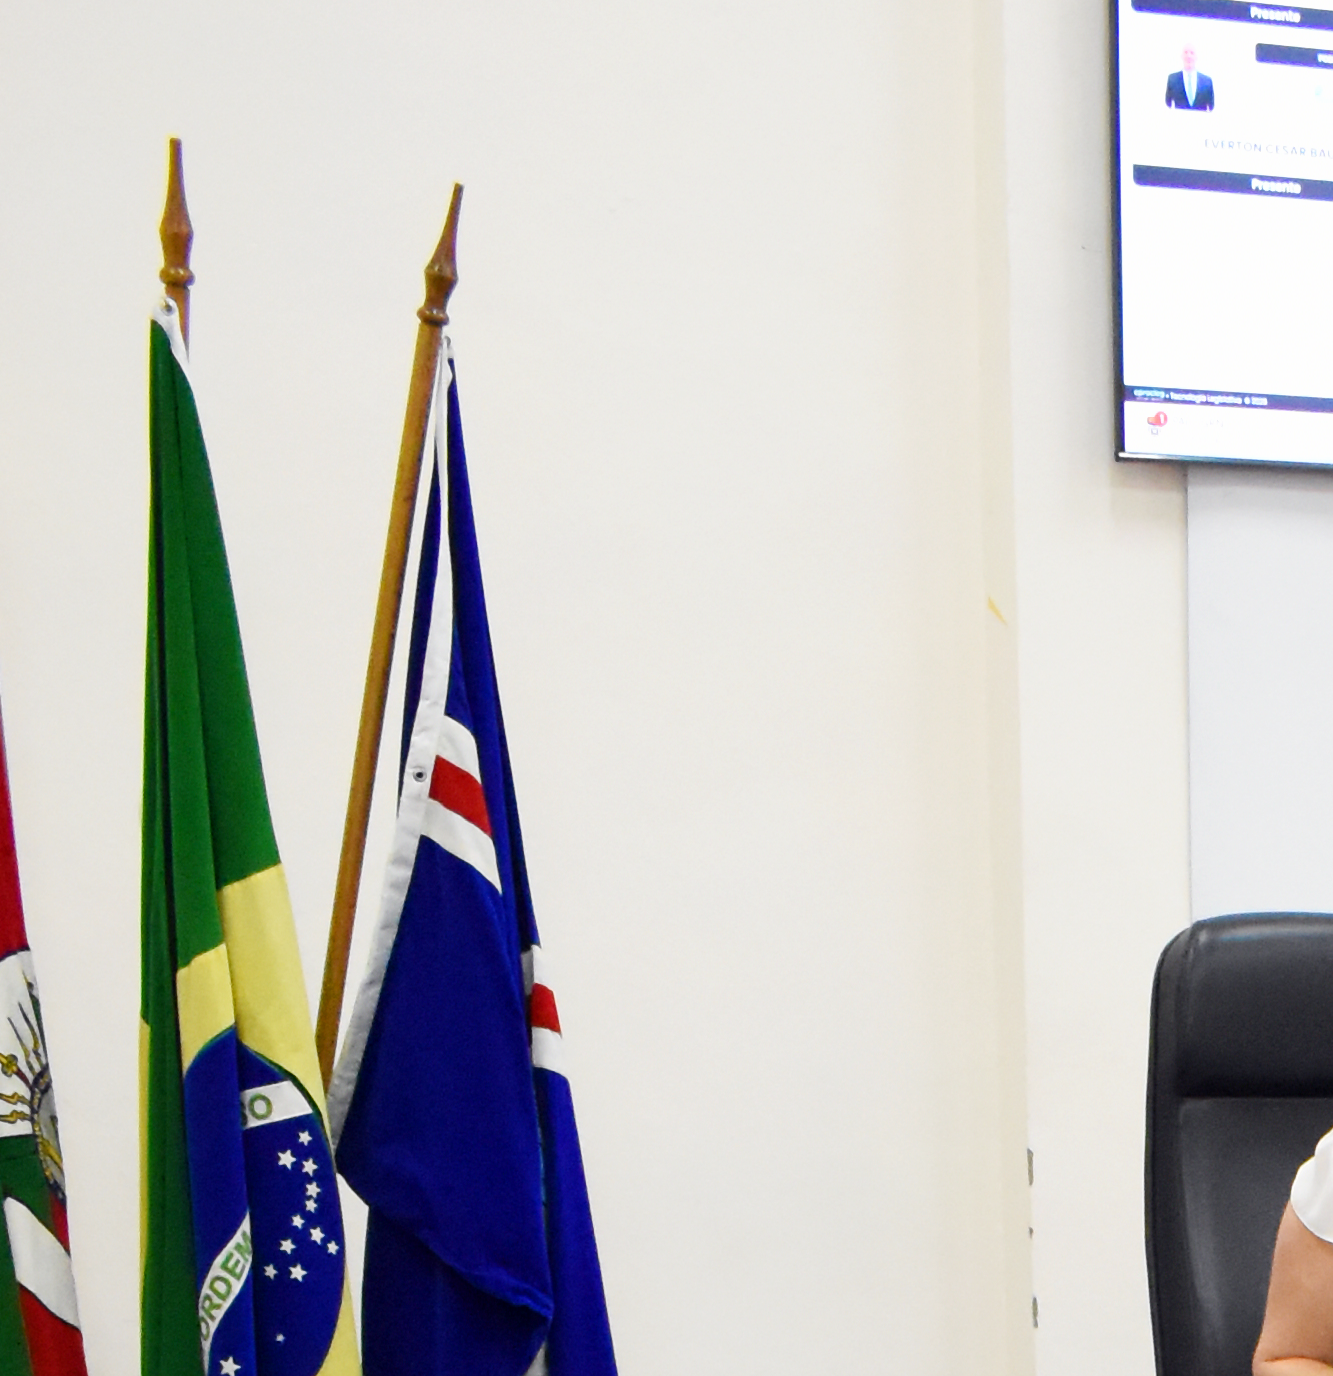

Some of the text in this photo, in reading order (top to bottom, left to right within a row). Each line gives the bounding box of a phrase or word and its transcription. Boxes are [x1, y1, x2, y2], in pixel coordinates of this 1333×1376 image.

[1250, 5, 1301, 24] Presente
[1204, 138, 1262, 153] EVERTON
[1265, 144, 1306, 157] CESAR
[1252, 177, 1302, 195] Presente
